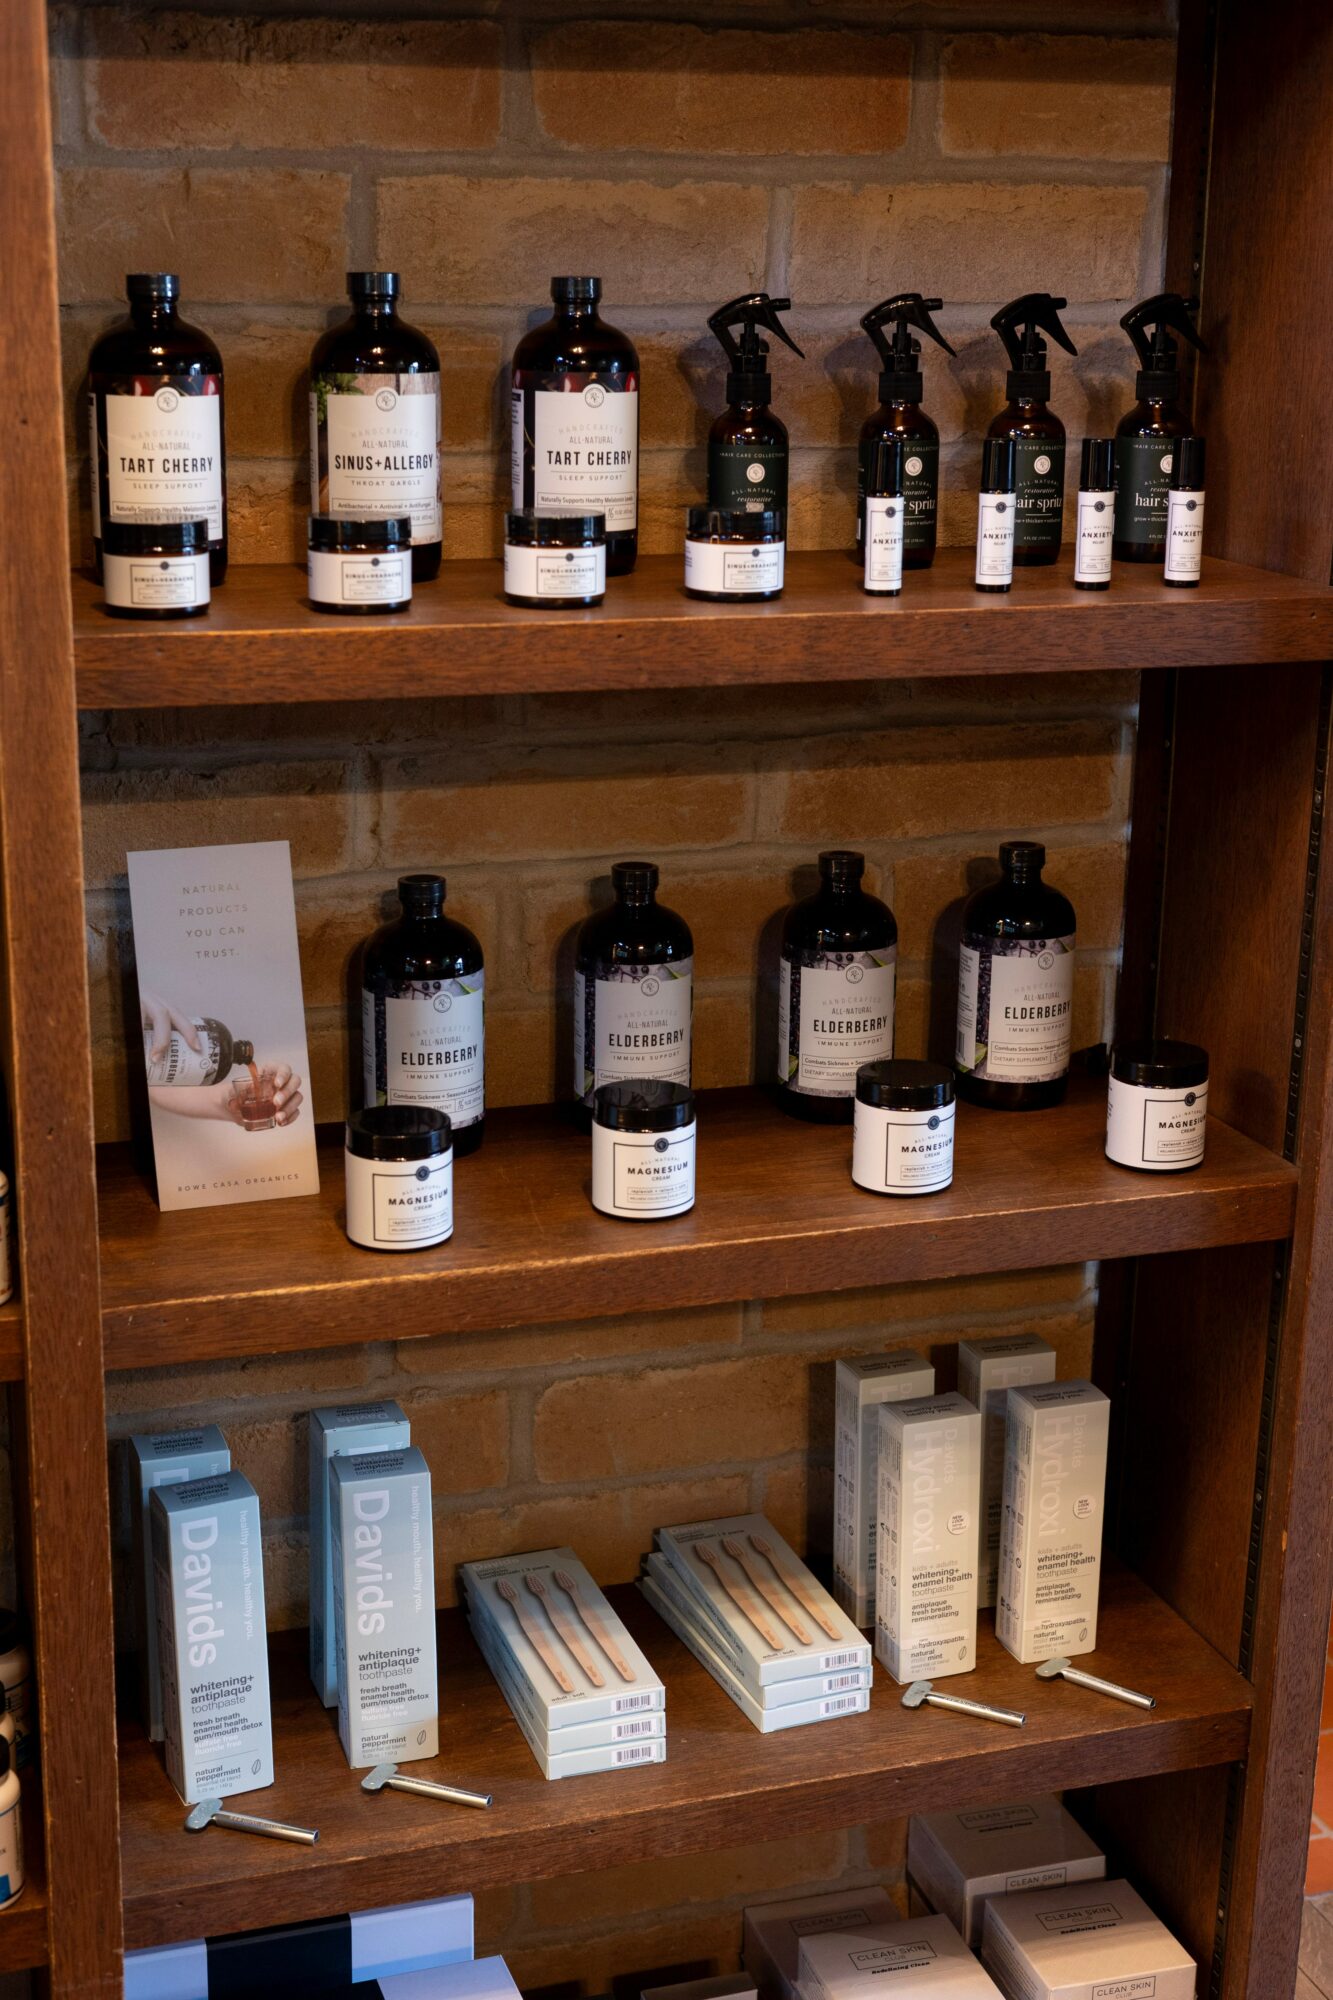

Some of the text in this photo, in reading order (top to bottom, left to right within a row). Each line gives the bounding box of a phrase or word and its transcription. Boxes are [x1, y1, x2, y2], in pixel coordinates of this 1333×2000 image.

[142, 442, 190, 451] ALL-NATURAL
[362, 440, 408, 448] ALL-NATURAL
[570, 436, 614, 444] ALL-NATURAL
[335, 454, 433, 470] SINUS+ALLERGY
[547, 450, 632, 466] TART CHERRY
[120, 457, 213, 473] TART CHERRY
[732, 488, 776, 496] ALL-NATURAL
[909, 496, 936, 514] spritz
[1036, 494, 1062, 512] spritz
[1135, 492, 1160, 506] hair
[182, 884, 240, 894] NATURAL
[179, 904, 248, 917] PRODUCTS
[186, 926, 245, 938] YOU CAN
[195, 948, 240, 959] TRUST.
[1024, 992, 1061, 1001] ALL-NATURAL
[832, 1006, 872, 1015] ALL-NATURAL
[1004, 1000, 1070, 1020] ELDERBERRY
[628, 1019, 669, 1028] ALL-NATURAL
[814, 1016, 888, 1034] ELDERBERRY
[420, 1036, 462, 1046] ALL-NATURAL
[609, 1028, 684, 1048] ELDERBERRY
[854, 1037, 884, 1046] SUPPORT
[165, 1040, 179, 1083] ELDERBERRY
[402, 1044, 478, 1066] ELDERBERRY
[650, 1050, 680, 1060] SUPPORT
[828, 1058, 850, 1066] Sickness
[444, 1068, 474, 1078] SUPPORT
[600, 1072, 622, 1080] Combats
[804, 1068, 825, 1076] DIETARY
[446, 1090, 468, 1098] Seasonal
[901, 1137, 953, 1153] MAGNESIUM
[627, 1161, 688, 1175] MAGNESIUM
[178, 1173, 300, 1192] ROWE CASA ORGANICS
[388, 1188, 448, 1206] MAGNESIUM
[1072, 1414, 1087, 1469] Davids
[944, 1428, 958, 1484] Davids
[1038, 1416, 1073, 1538] Hydroxi
[907, 1430, 943, 1554] Hydroxi
[411, 1486, 420, 1521] healthy
[352, 1490, 394, 1636] Davids
[1037, 1556, 1096, 1571] enamel health
[1038, 1551, 1083, 1564] whitening+
[414, 1556, 423, 1597] healthy
[912, 1568, 960, 1580] whitening+
[1036, 1567, 1078, 1579] toothpaste
[912, 1572, 972, 1589] enamel health
[1036, 1582, 1070, 1592] antiplaque
[181, 1516, 224, 1667] Davids
[912, 1584, 954, 1598] toothpaste
[1036, 1587, 1076, 1598] fresh breath
[912, 1600, 948, 1610] antiplaque
[1036, 1593, 1082, 1604] remineralizing
[912, 1605, 952, 1616] fresh breath
[912, 1610, 960, 1623] remineralizing
[1042, 1617, 1086, 1630] hydroxyapatite
[1034, 1630, 1057, 1639] natural
[1050, 1634, 1064, 1642] mint
[918, 1636, 965, 1648] hydroxyapatite
[358, 1647, 422, 1662] whitening+
[910, 1648, 934, 1658] natural
[928, 1653, 942, 1661] mint
[358, 1656, 420, 1672] antiplaque
[359, 1666, 413, 1681] toothpaste
[190, 1674, 254, 1694] whitening+
[360, 1682, 407, 1694] fresh breath
[190, 1684, 252, 1705] antiplaque
[360, 1688, 415, 1701] enamel health
[192, 1694, 246, 1714] toothpaste
[360, 1694, 429, 1710] gum/mouth detox
[193, 1712, 240, 1728] fresh breath
[194, 1717, 248, 1735] enamel health
[194, 1721, 263, 1744] gum/mouth detox
[362, 1732, 389, 1742] natural
[362, 1736, 407, 1749] peppermint
[196, 1764, 223, 1776] natural
[196, 1767, 241, 1784] peppermint
[965, 1812, 1000, 1822] CLEAN
[1010, 1872, 1062, 1888] CLEAN SKIN
[798, 1912, 863, 1929] CLEAN SKIN
[1044, 1906, 1112, 1922] CLEAN SKIN
[1060, 1925, 1096, 1935] Redefining
[856, 1944, 928, 1962] CLEAN SKIN
[872, 1964, 909, 1975] Redefining
[1096, 1981, 1152, 1997] CLEAN SKIN
